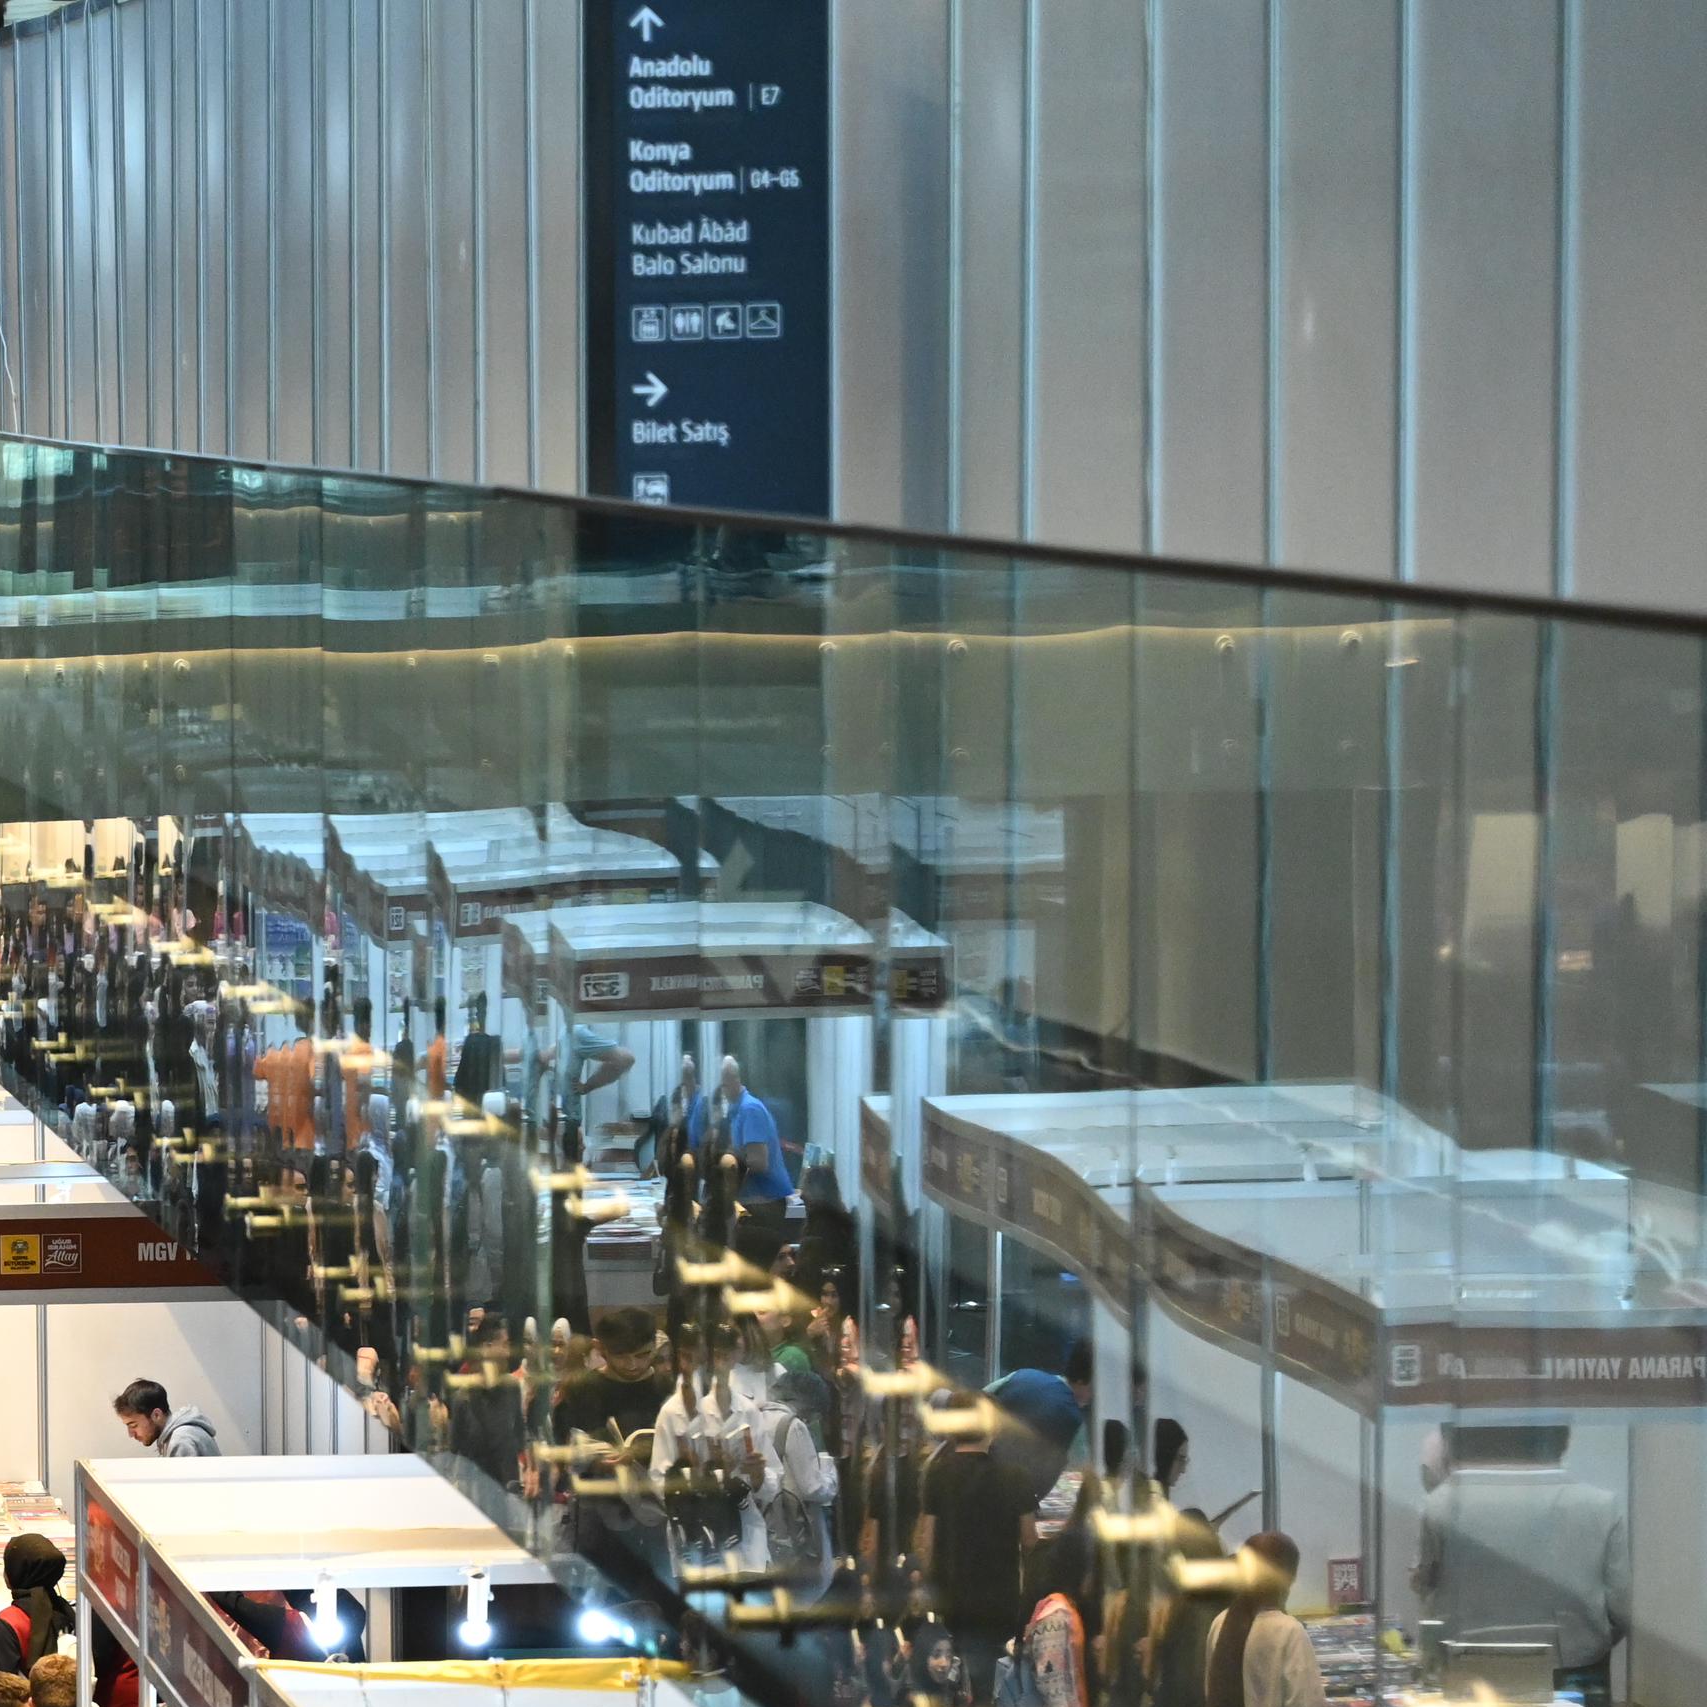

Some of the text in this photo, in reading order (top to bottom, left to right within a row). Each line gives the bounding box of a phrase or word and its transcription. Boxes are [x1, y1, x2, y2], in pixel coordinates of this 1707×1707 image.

[629, 55, 712, 78] Anadolu
[629, 86, 781, 112] Oditoryum E7
[629, 139, 692, 166] Konya
[629, 169, 735, 196] Oditoryum
[631, 221, 693, 246] Kubad
[632, 251, 747, 277] Balo Salonu
[632, 417, 731, 446] Bilet Satış
[138, 1242, 178, 1262] MGV
